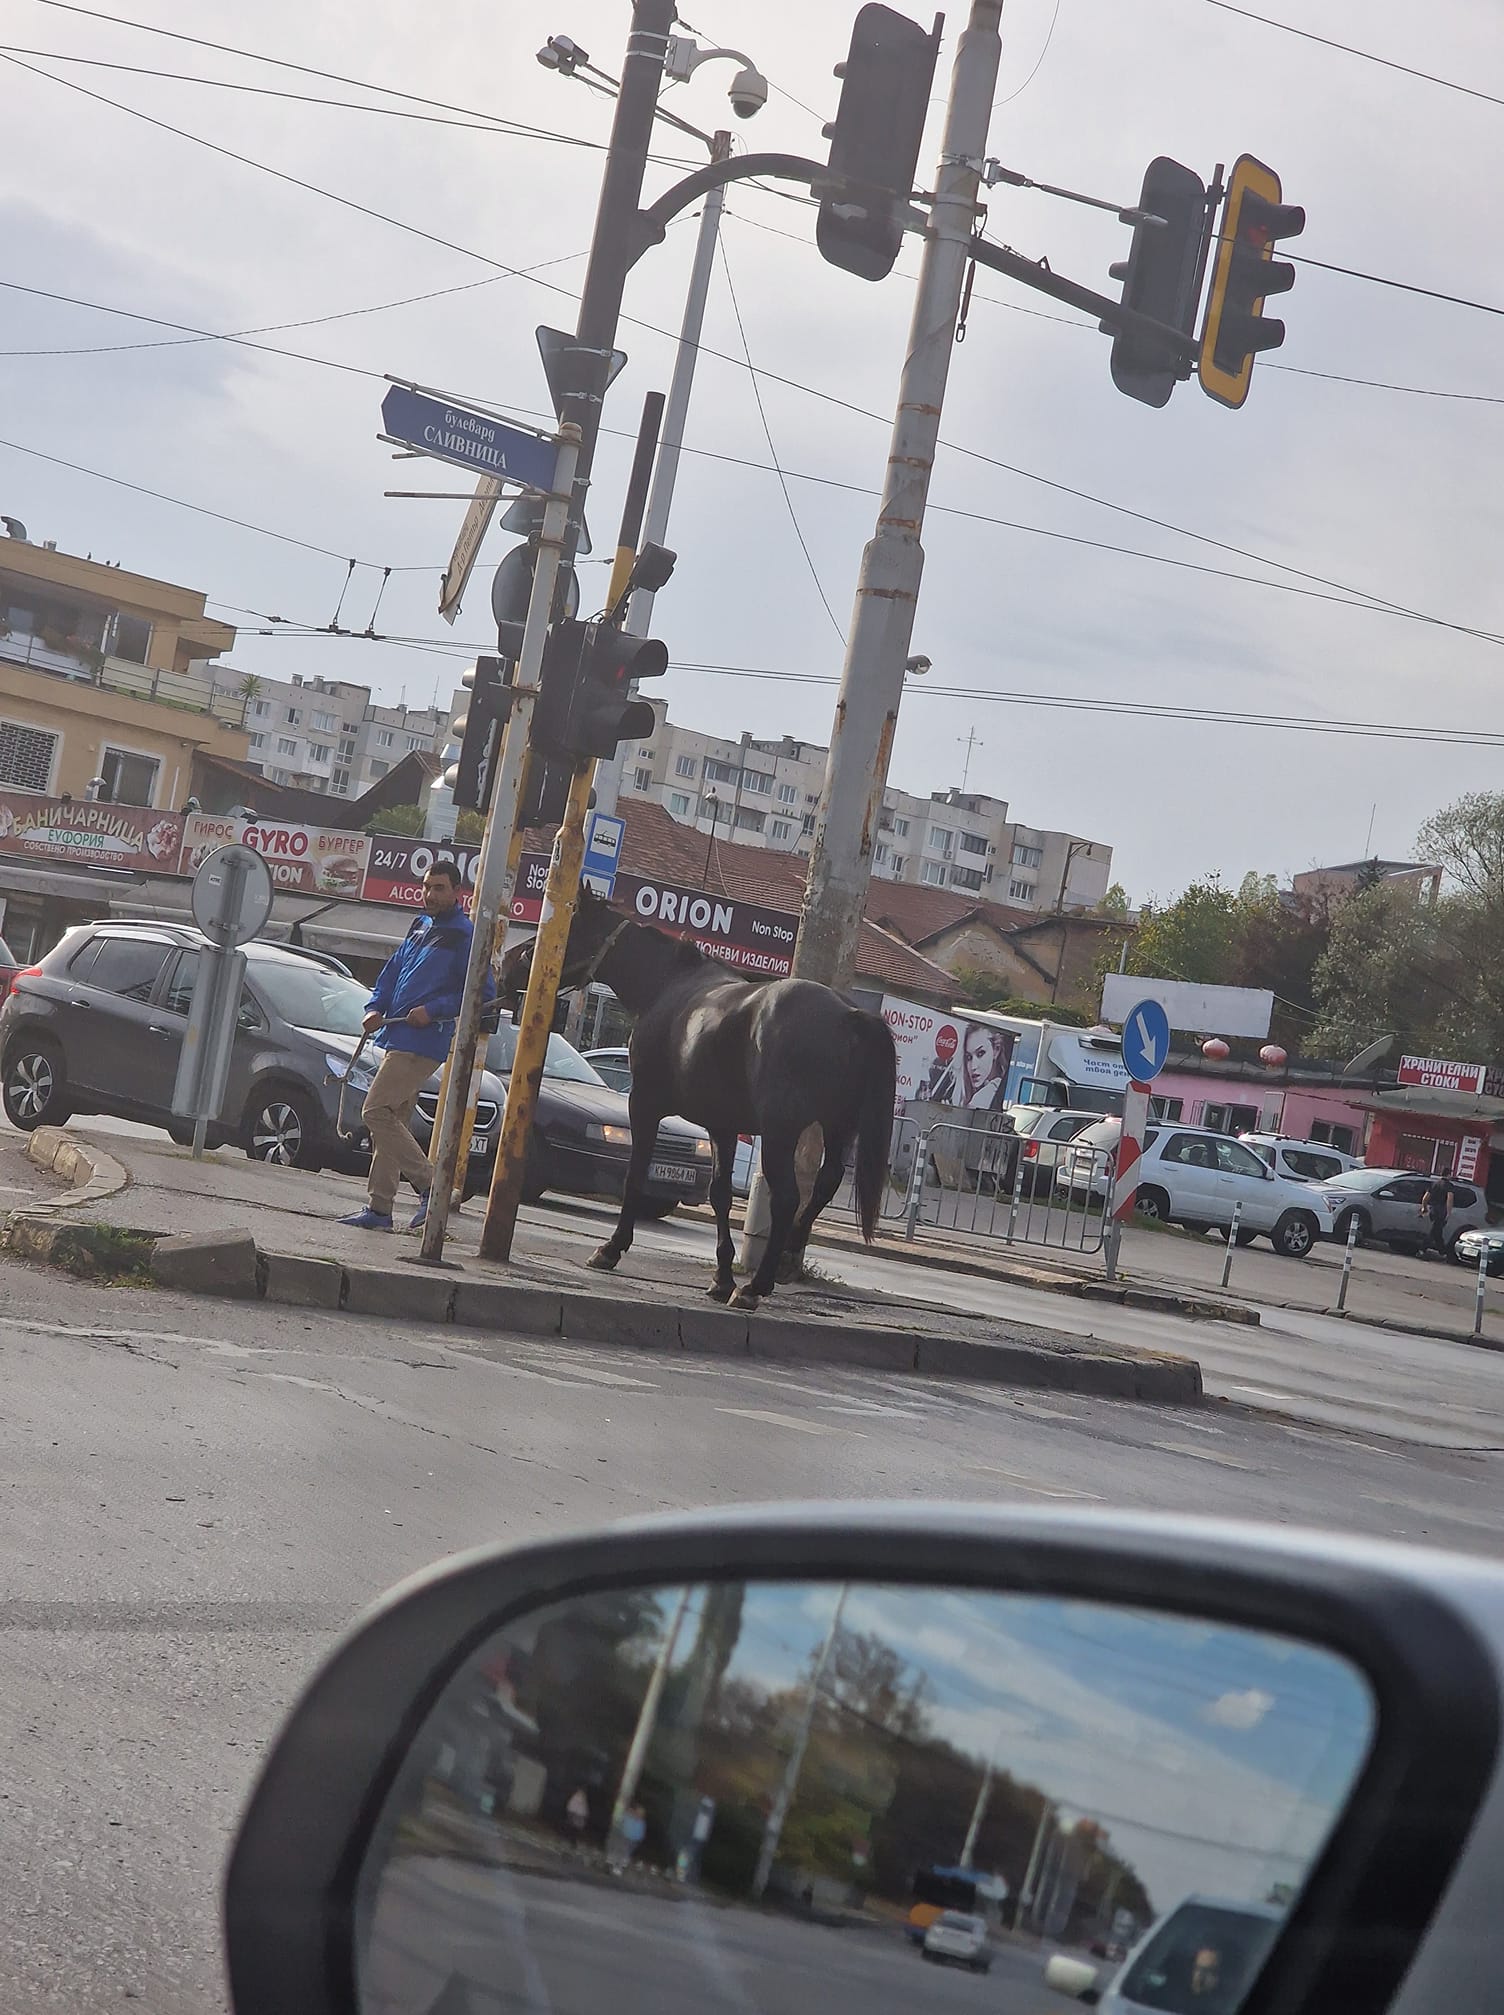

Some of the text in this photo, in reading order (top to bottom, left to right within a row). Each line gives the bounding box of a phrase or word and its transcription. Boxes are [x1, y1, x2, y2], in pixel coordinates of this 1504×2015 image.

[445, 410, 495, 442] булевард
[424, 425, 506, 469] СЛИВНИЦА
[13, 806, 144, 852] БАНИЧАРНИЦА
[48, 829, 104, 848] ЕУФОРИЯ
[193, 821, 234, 839] ГИРОС
[242, 826, 308, 856] GYRO
[318, 836, 364, 854] БУРГЕР
[374, 849, 408, 870] 24/7
[635, 886, 733, 934] ORION
[751, 919, 794, 944] Non Stop
[741, 951, 790, 974] ИЗДЕЛИЯ
[884, 1009, 933, 1032] NON-STOP
[1084, 1059, 1110, 1067] Част
[1403, 1057, 1479, 1078] ХРАНИТЕЛНИ
[1420, 1073, 1459, 1089] СТОКИ
